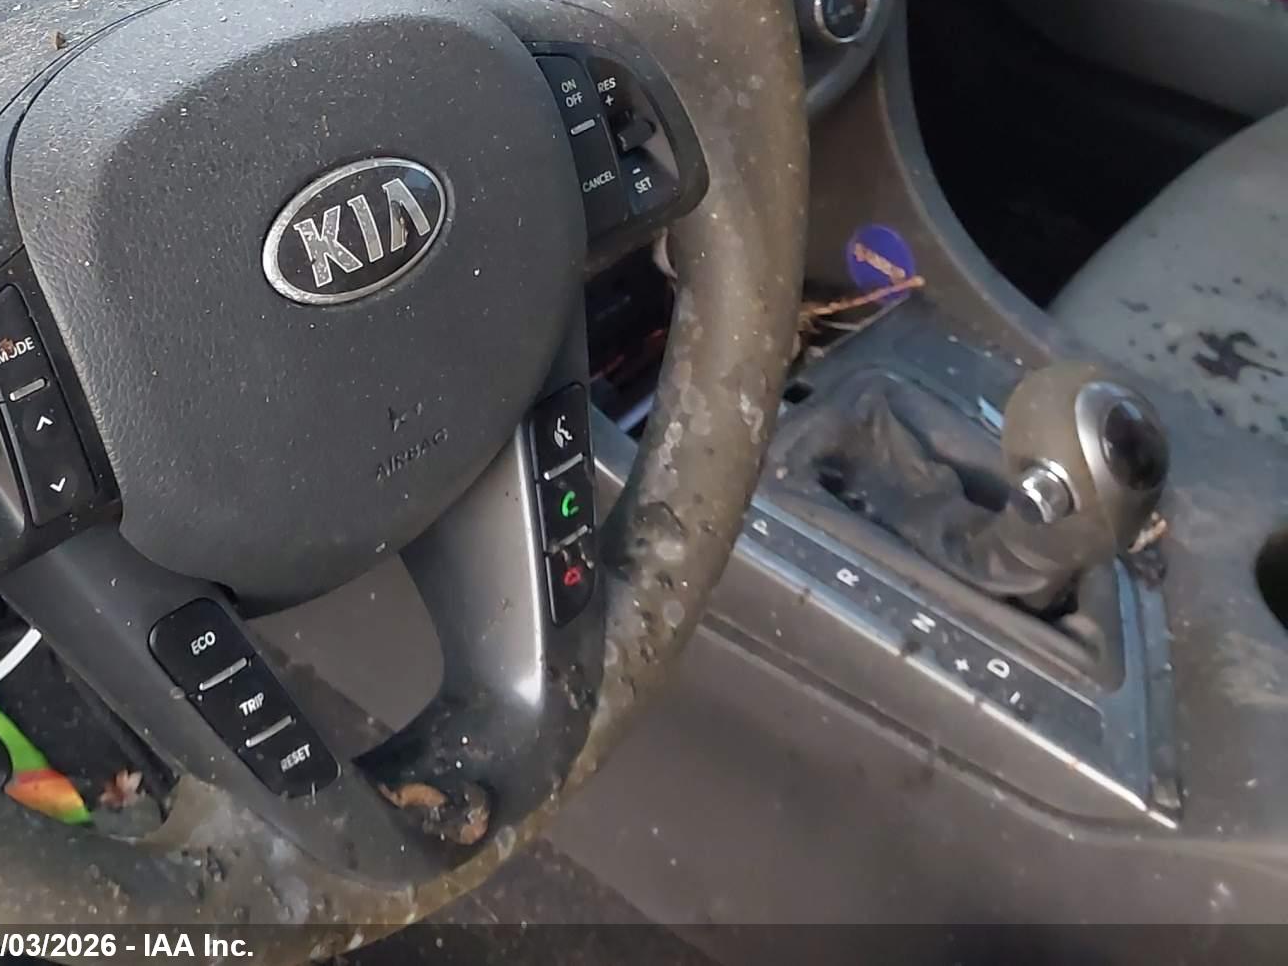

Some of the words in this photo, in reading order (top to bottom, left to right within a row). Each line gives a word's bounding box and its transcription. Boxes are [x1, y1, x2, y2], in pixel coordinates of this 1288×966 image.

[561, 78, 577, 94] ON
[597, 77, 616, 94] RES
[565, 91, 583, 107] OFF
[582, 170, 615, 193] CANCEL
[634, 176, 653, 194] SET
[293, 178, 431, 288] KIA
[752, 518, 770, 535] P
[836, 567, 860, 587] R
[911, 612, 936, 634] N
[190, 631, 216, 655] ECO
[987, 657, 1011, 679] D
[238, 692, 265, 716] TRIP
[280, 743, 312, 773] RESET
